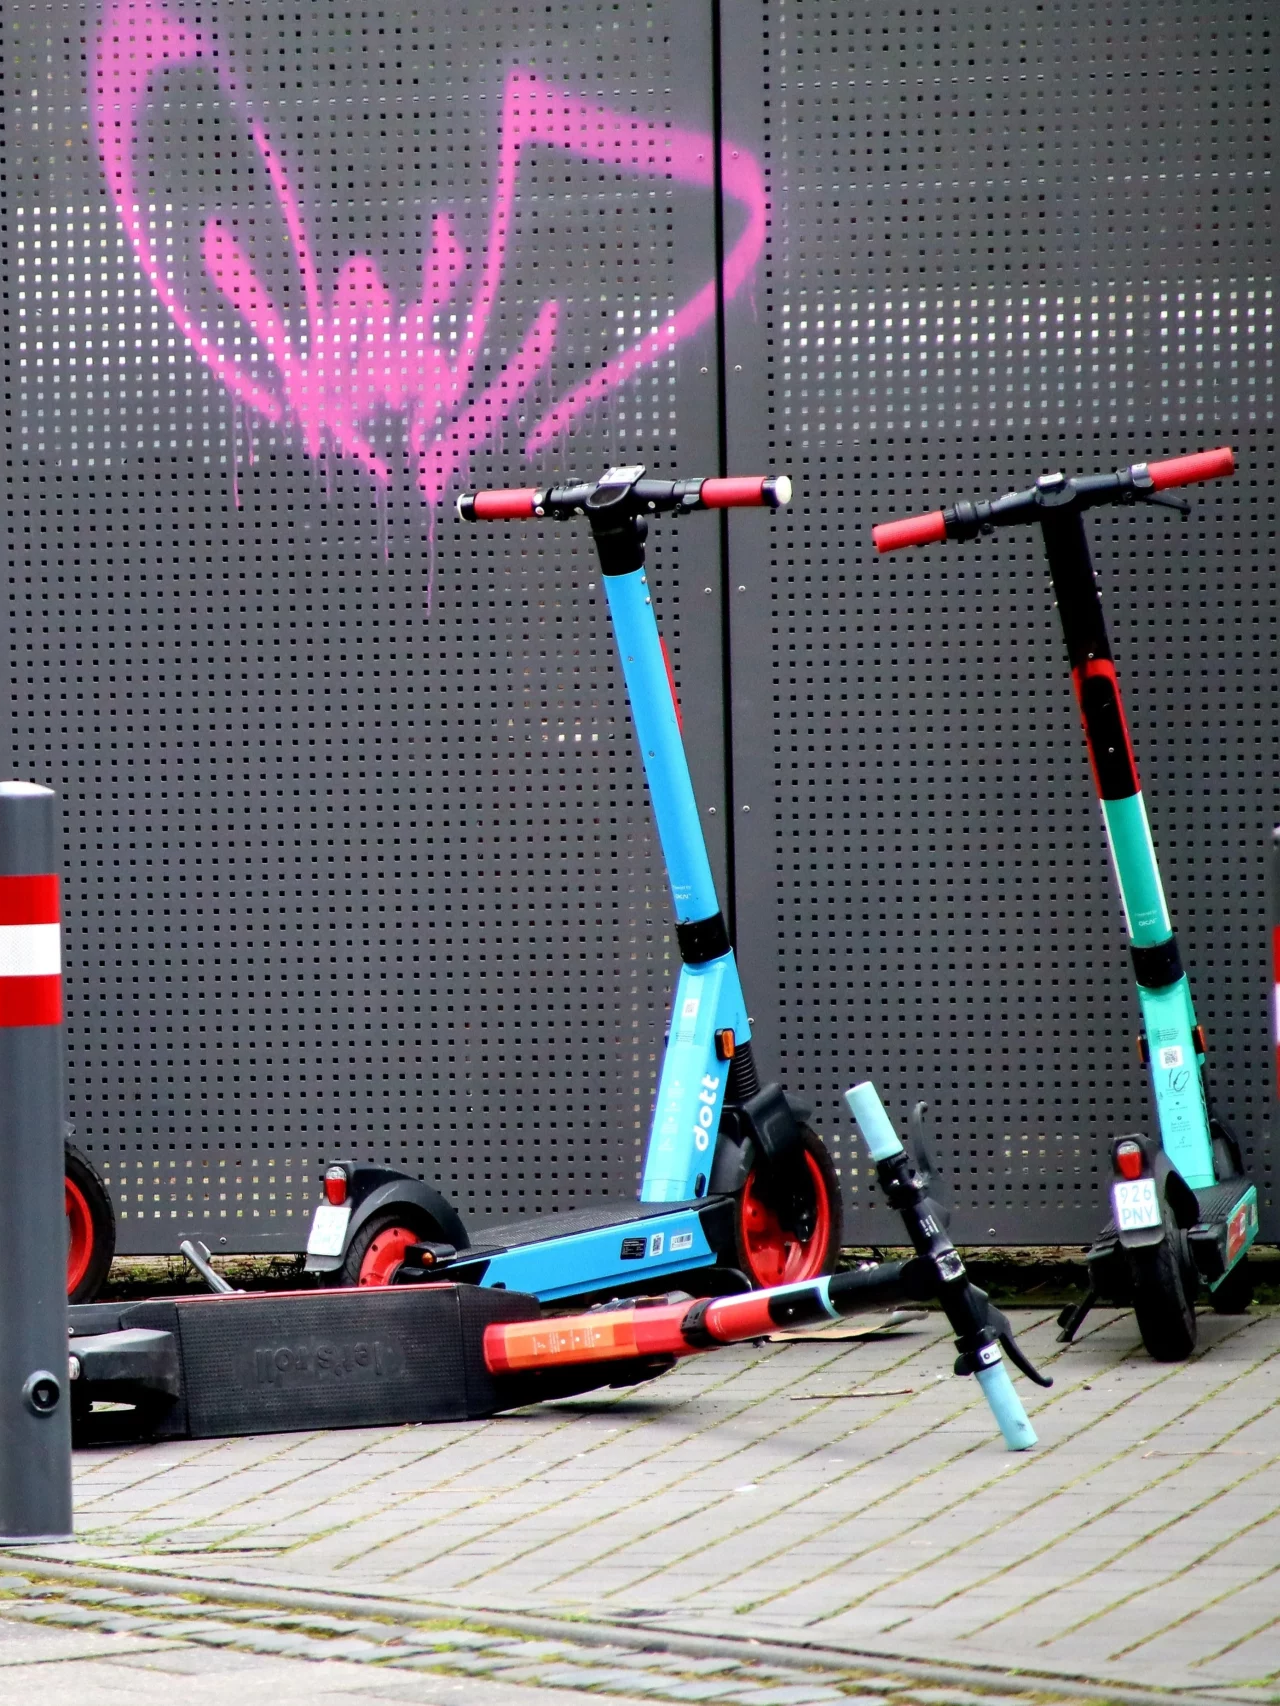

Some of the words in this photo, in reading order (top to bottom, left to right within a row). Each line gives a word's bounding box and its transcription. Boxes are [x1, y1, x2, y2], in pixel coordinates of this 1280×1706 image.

[693, 1073, 720, 1152] dott
[1119, 1184, 1152, 1205] 926
[1121, 1205, 1154, 1226] PNY
